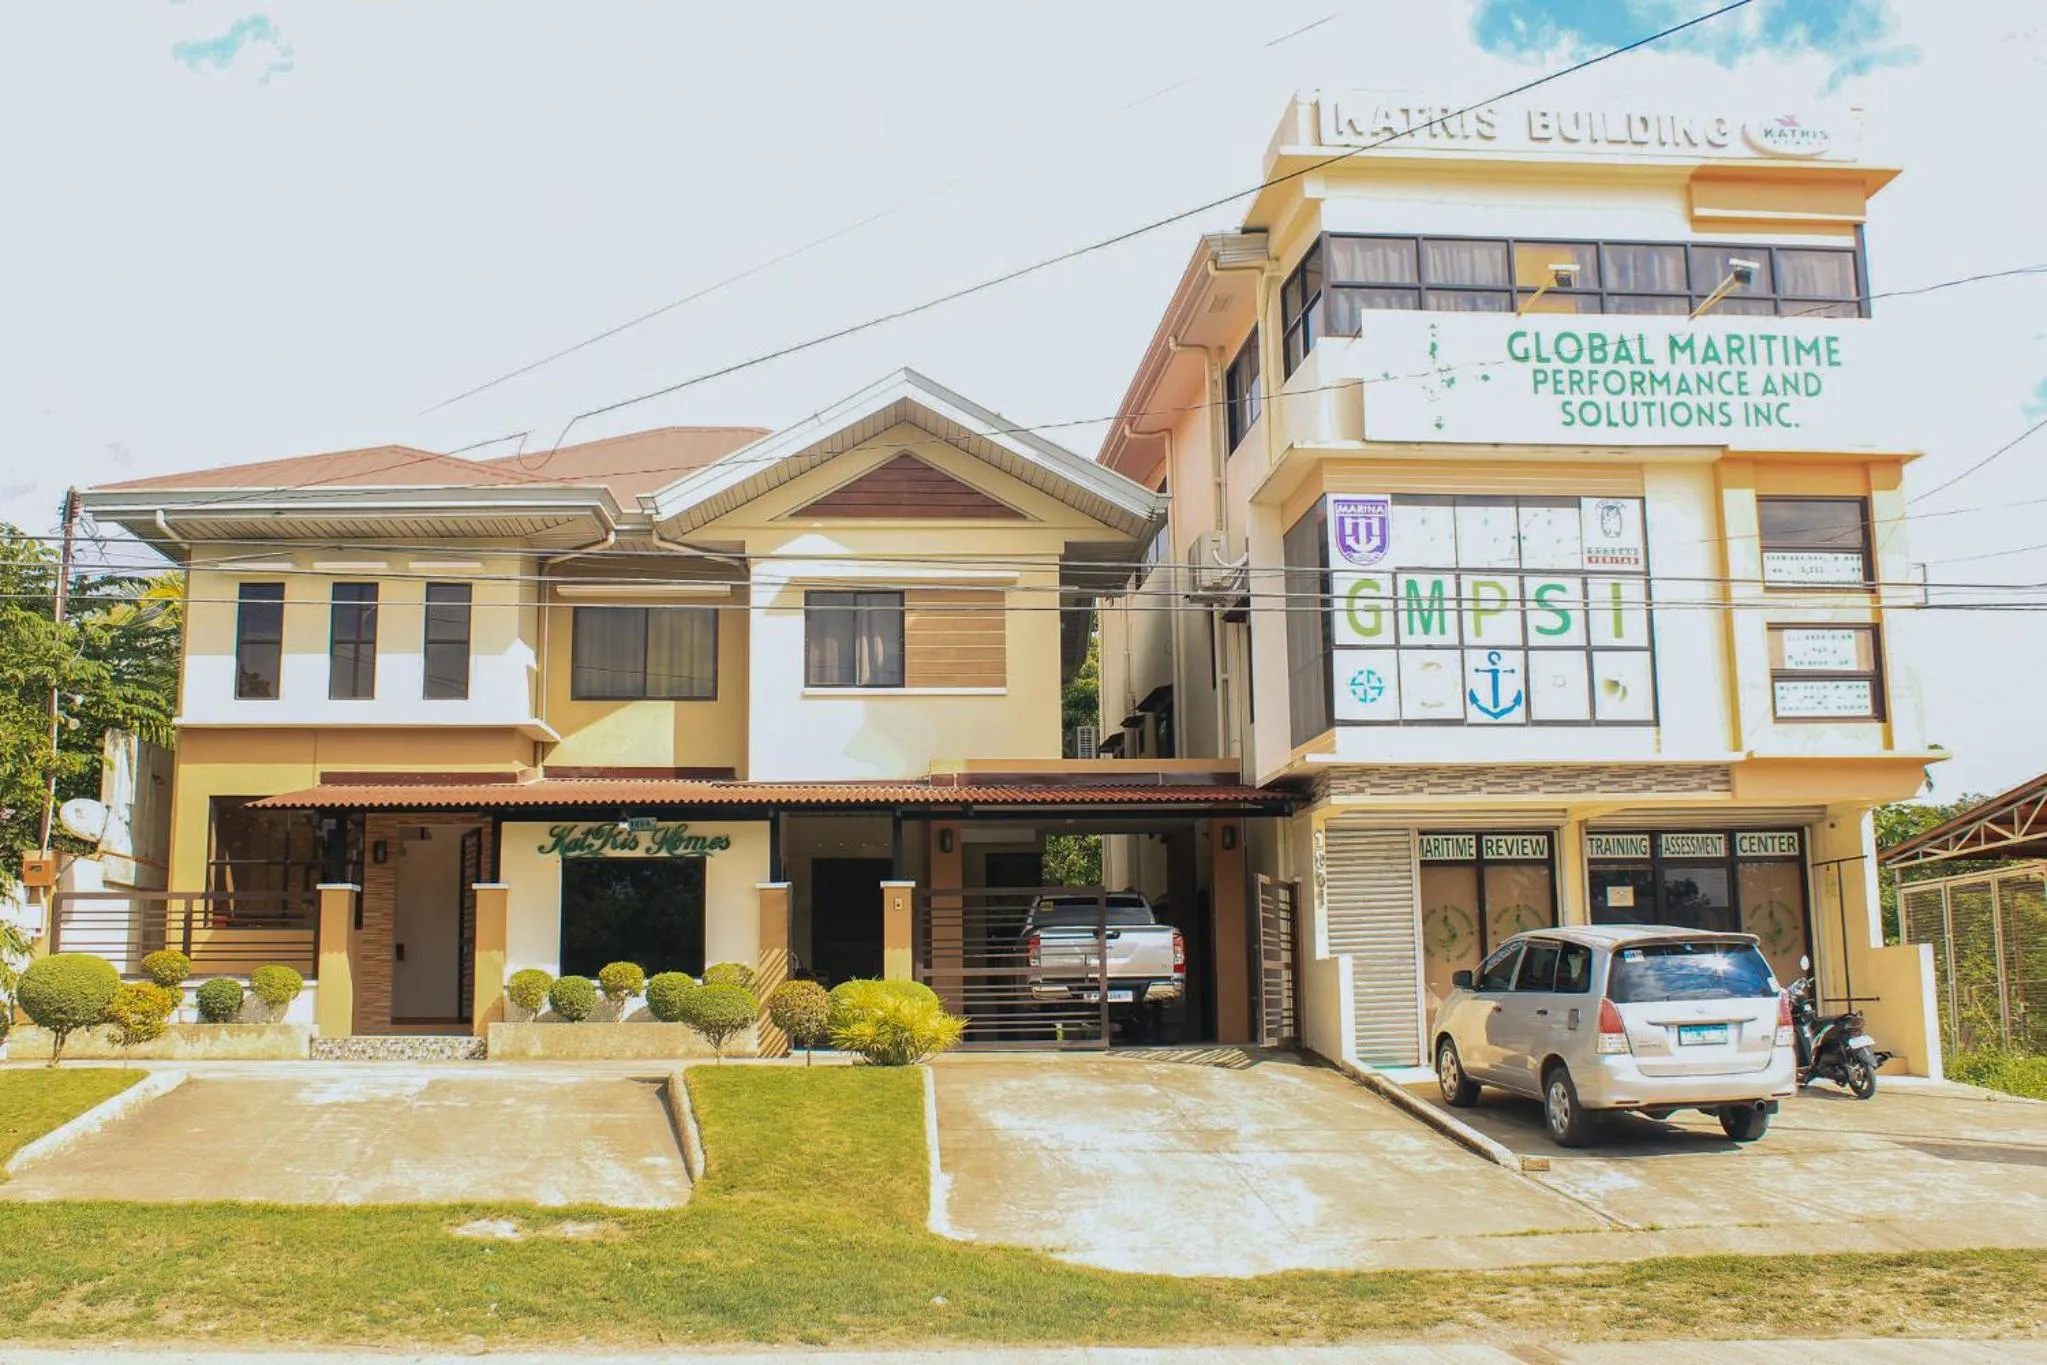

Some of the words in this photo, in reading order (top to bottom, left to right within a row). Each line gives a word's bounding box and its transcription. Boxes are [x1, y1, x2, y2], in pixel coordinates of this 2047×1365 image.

[1333, 102, 1498, 141] KATRIS
[1526, 108, 1730, 148] BUILDING
[1506, 330, 1655, 365] GLOBAL
[1668, 332, 1842, 367] MARITIME
[1532, 368, 1749, 397] PERFORMANCE
[1761, 371, 1823, 398] AND
[1560, 400, 1733, 428] SOLUTIONS
[1743, 401, 1801, 428] INC.
[1336, 503, 1386, 515] MARINA
[1346, 578, 1625, 639] GMPSI
[645, 823, 732, 857] Homes
[1484, 837, 1546, 857] REVIEW
[1587, 837, 1649, 856] TRAINING
[1663, 835, 1723, 856] ASSESSMENT
[1738, 834, 1798, 854] CENTER
